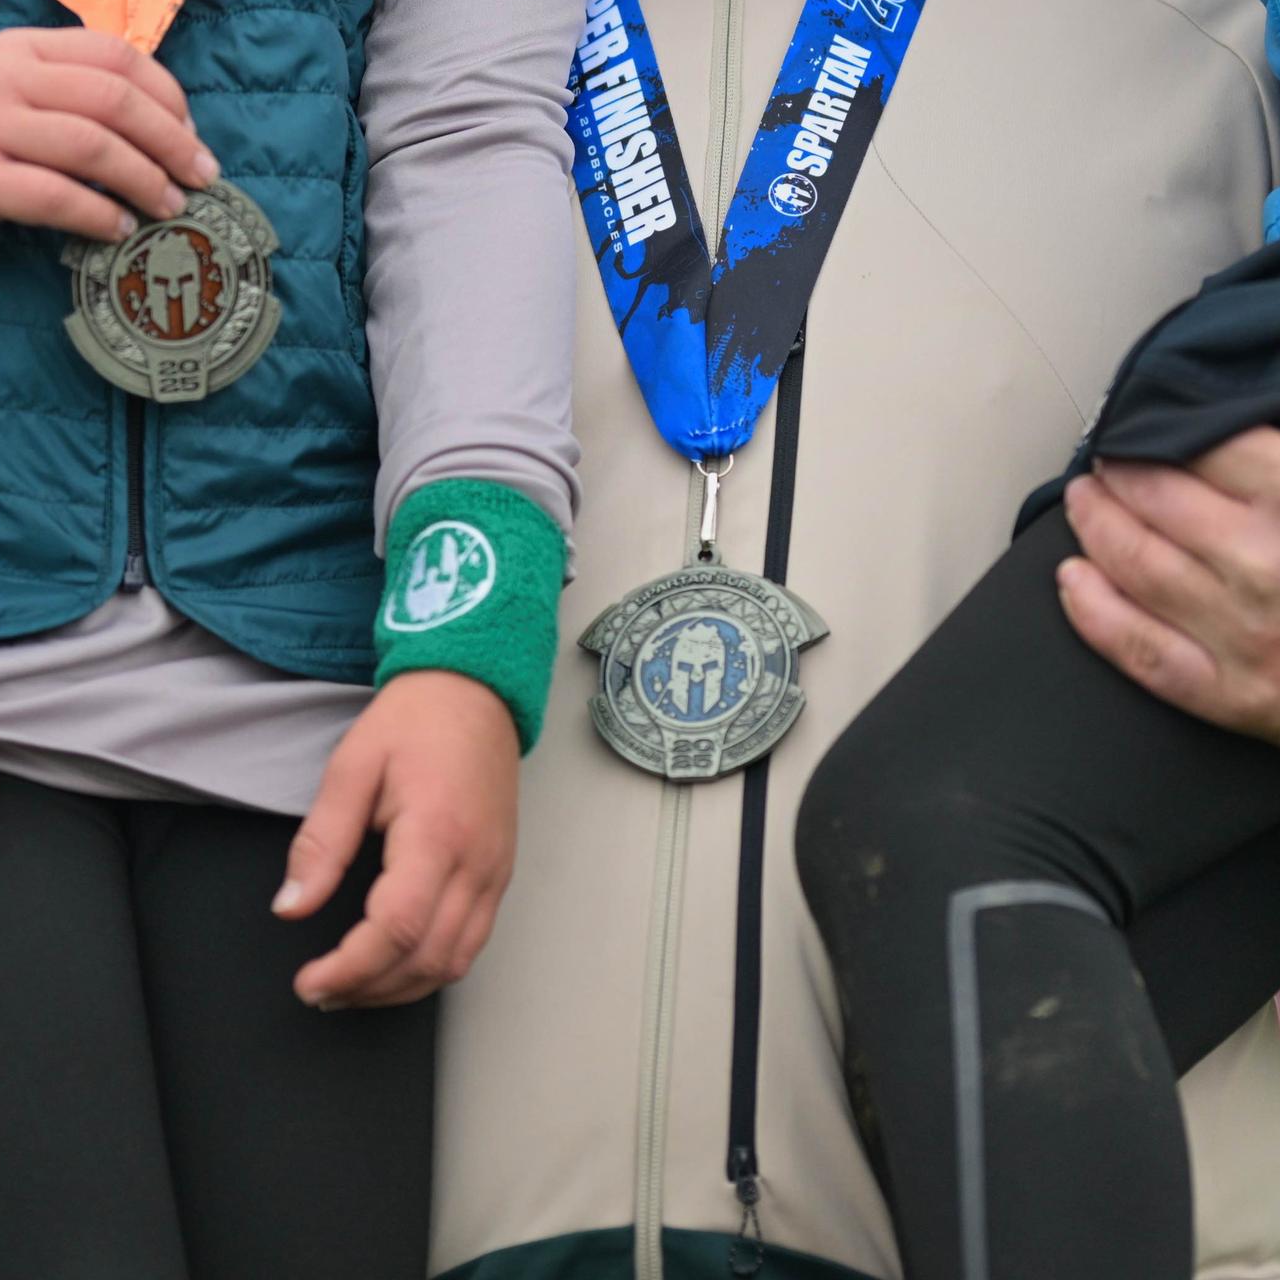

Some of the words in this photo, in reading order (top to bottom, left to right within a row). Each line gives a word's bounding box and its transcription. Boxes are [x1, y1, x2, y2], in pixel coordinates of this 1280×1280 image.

[586, 58, 677, 246] FINISHER
[785, 33, 873, 178] SPARTAN
[579, 116, 593, 138] 25
[587, 144, 624, 253] OBSTACLES
